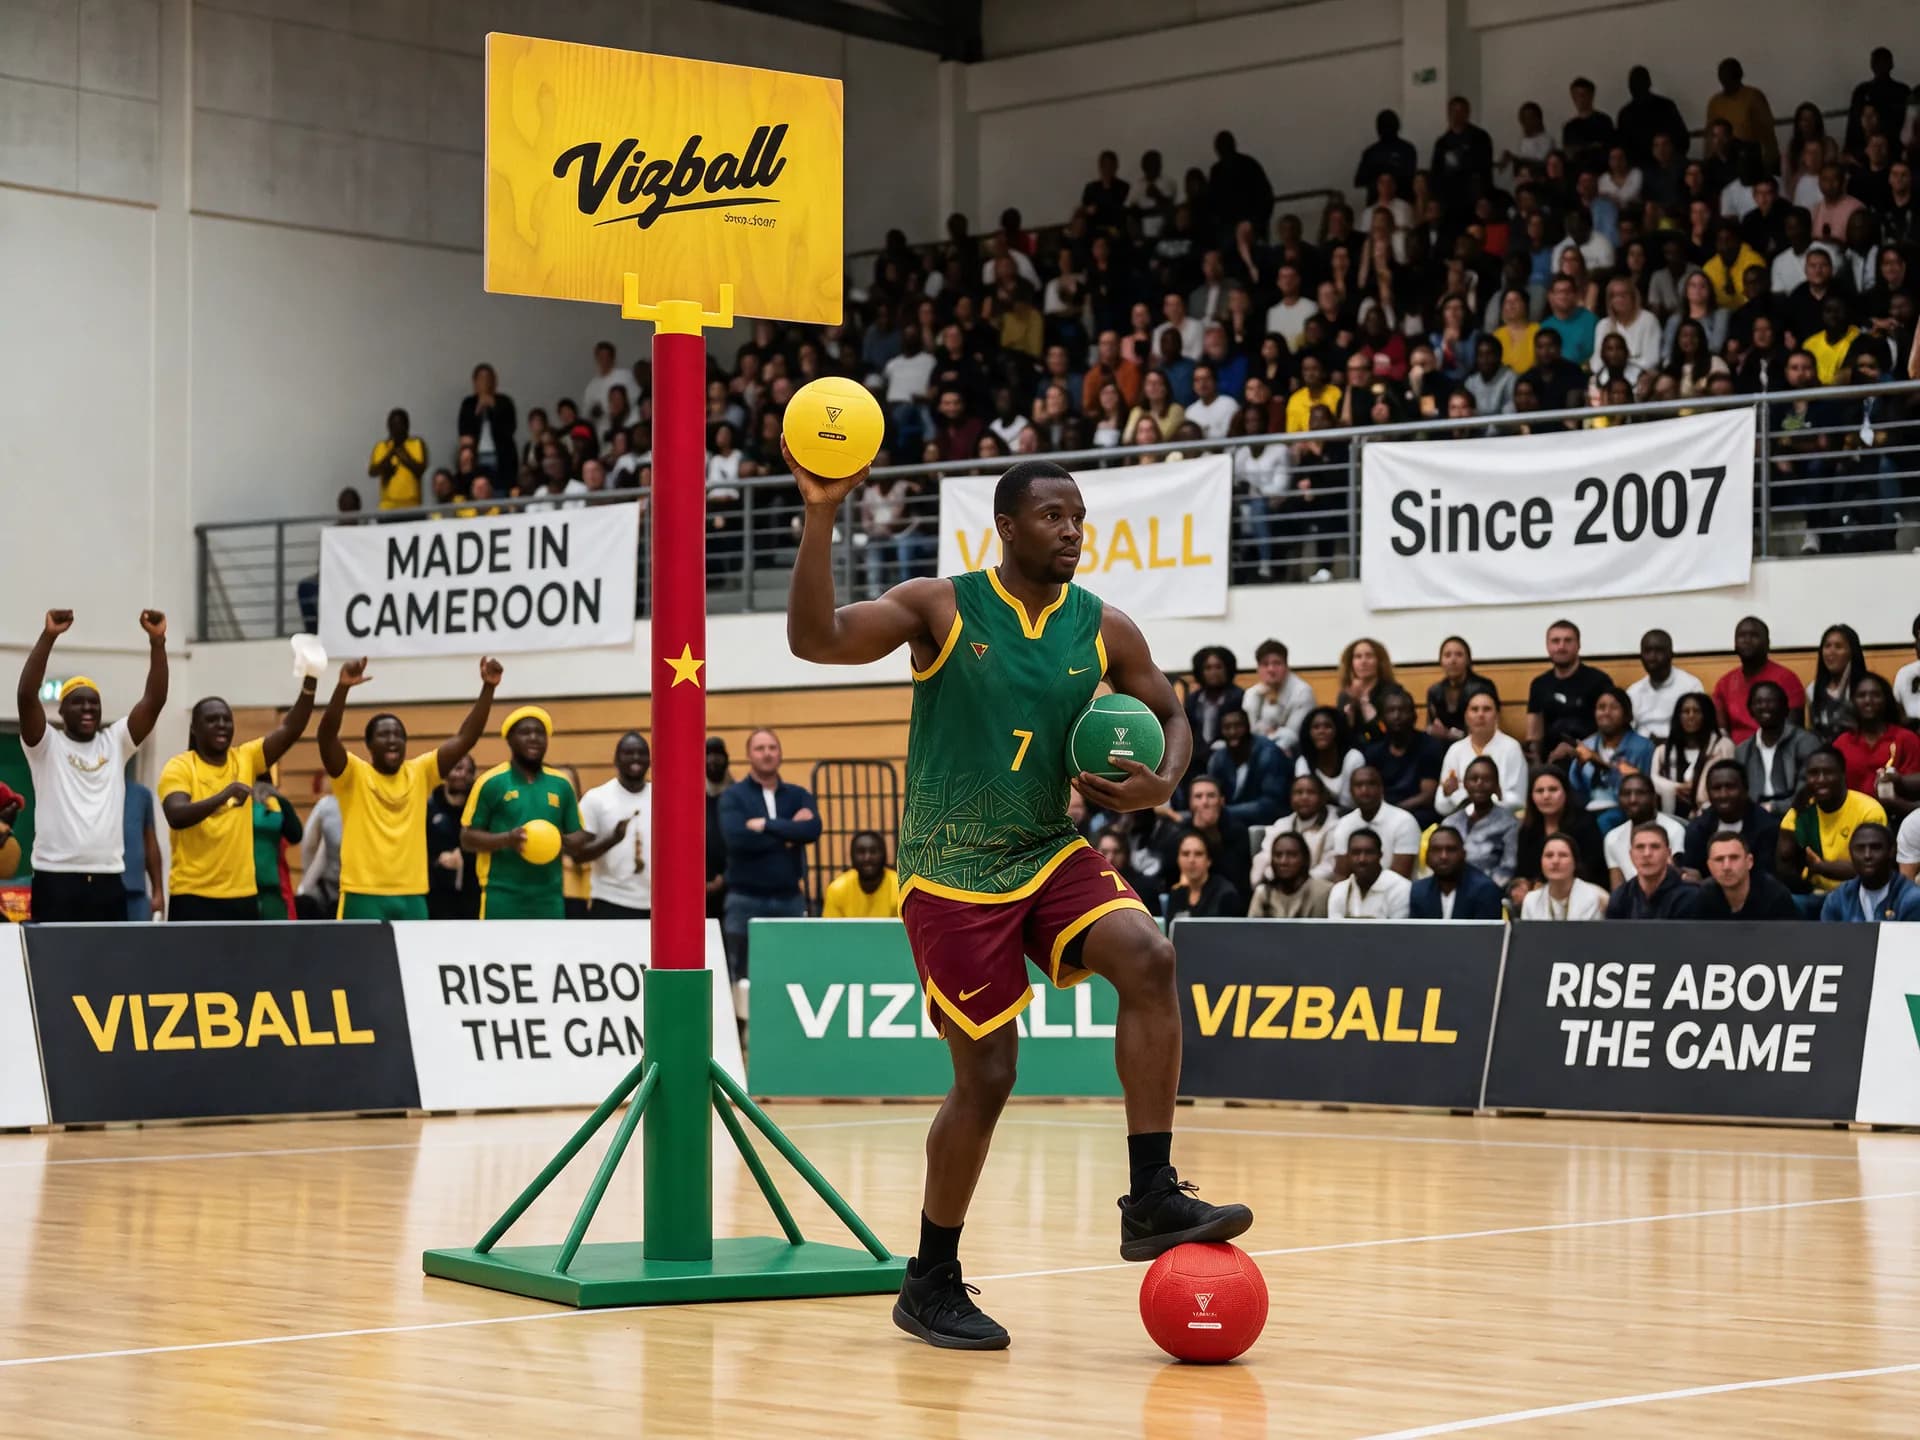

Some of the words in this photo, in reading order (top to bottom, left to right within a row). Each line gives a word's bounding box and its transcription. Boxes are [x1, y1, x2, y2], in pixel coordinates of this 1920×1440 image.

[553, 123, 789, 229] Vizball
[1391, 488, 1553, 556] Since
[1574, 465, 1727, 545] 2007
[387, 528, 511, 580] MADE
[528, 523, 569, 570] IN
[955, 513, 1212, 574] VBALL
[345, 578, 602, 638] CAMEROON
[1011, 729, 1034, 772] 7
[1100, 870, 1128, 892] 7
[439, 963, 538, 1006] RISE
[552, 962, 647, 1003] ABO
[785, 983, 1117, 1038] VIZLL
[1545, 961, 1656, 1010] RISE
[1662, 963, 1843, 1013] ABOVE
[72, 989, 376, 1053] VIZBALL
[461, 1018, 552, 1061] THE
[1192, 984, 1459, 1044] VIZBALL
[1560, 1019, 1656, 1068] THE
[1665, 1023, 1816, 1073] GAME
